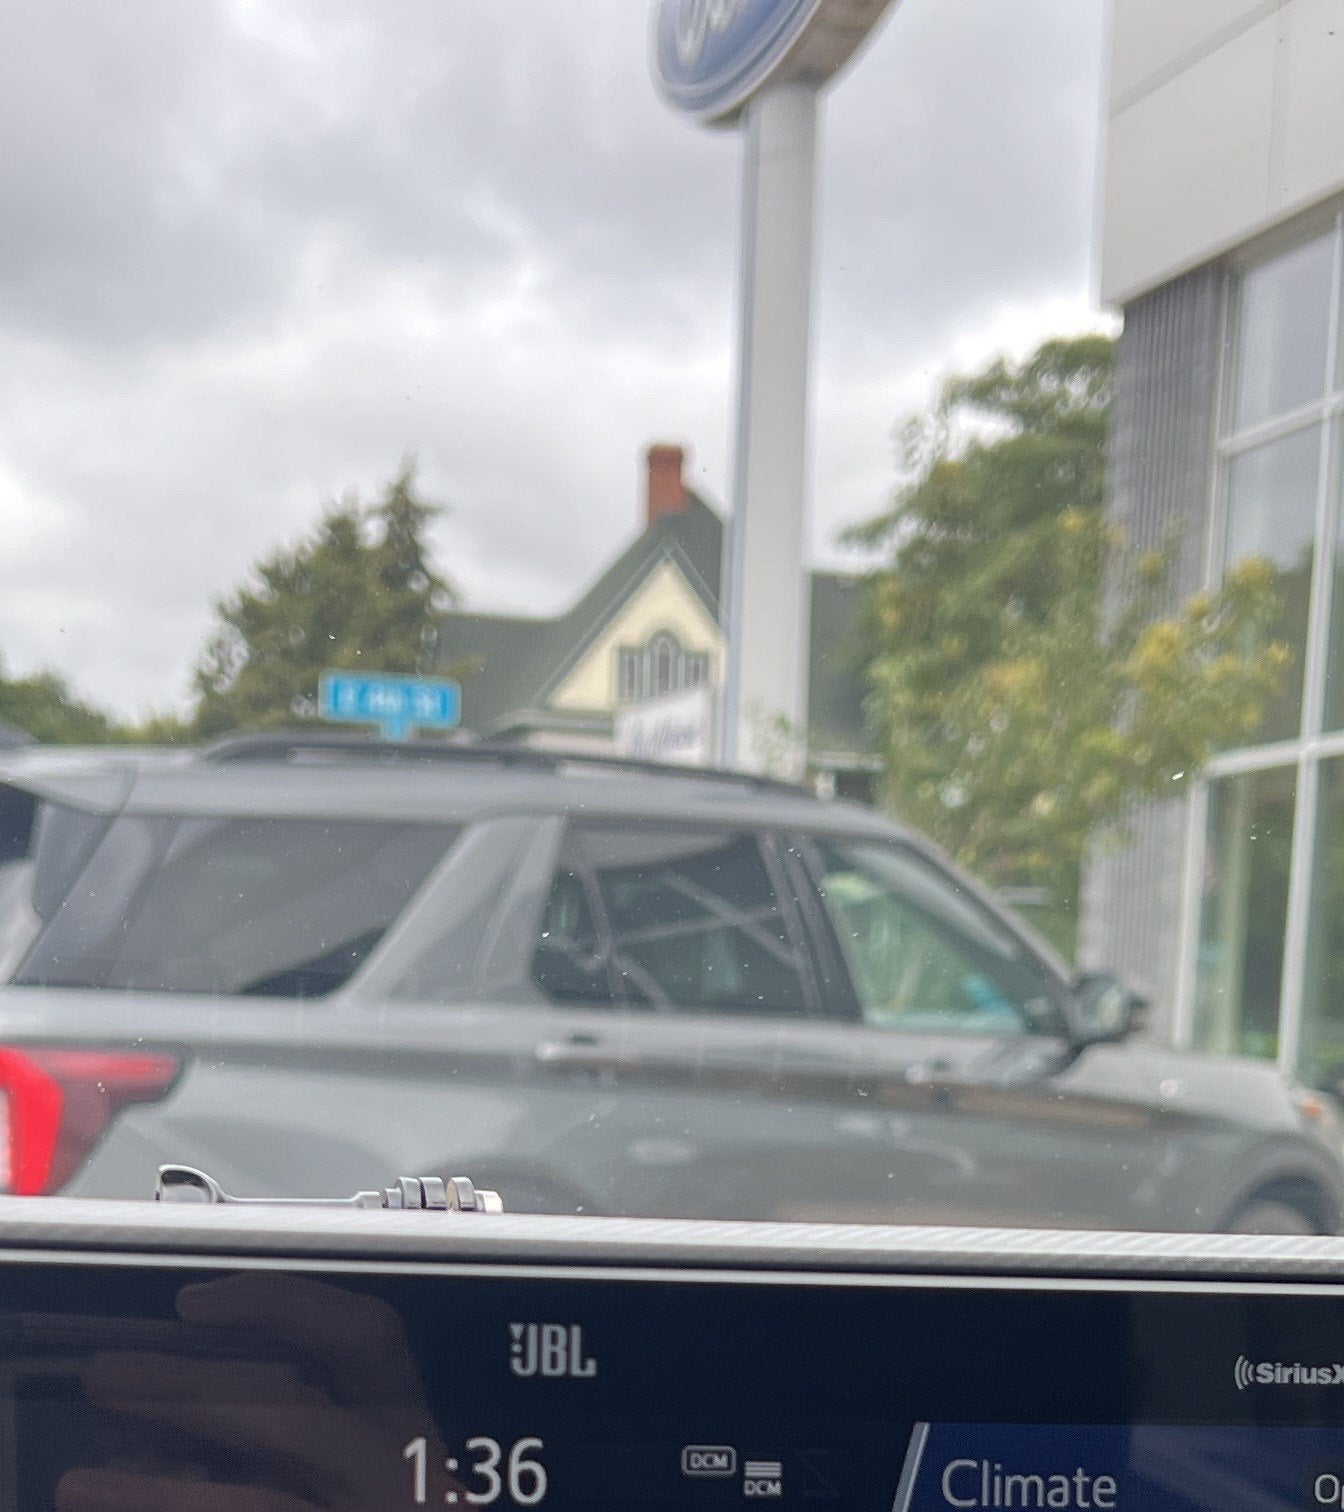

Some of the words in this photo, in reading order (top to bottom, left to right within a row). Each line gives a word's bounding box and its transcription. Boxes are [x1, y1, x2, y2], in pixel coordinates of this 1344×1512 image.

[509, 1323, 597, 1377] JBL
[402, 1436, 548, 1505] 1:36
[689, 1452, 730, 1471] DCM
[940, 1459, 1117, 1510] Climate
[744, 1479, 783, 1497] DCM
